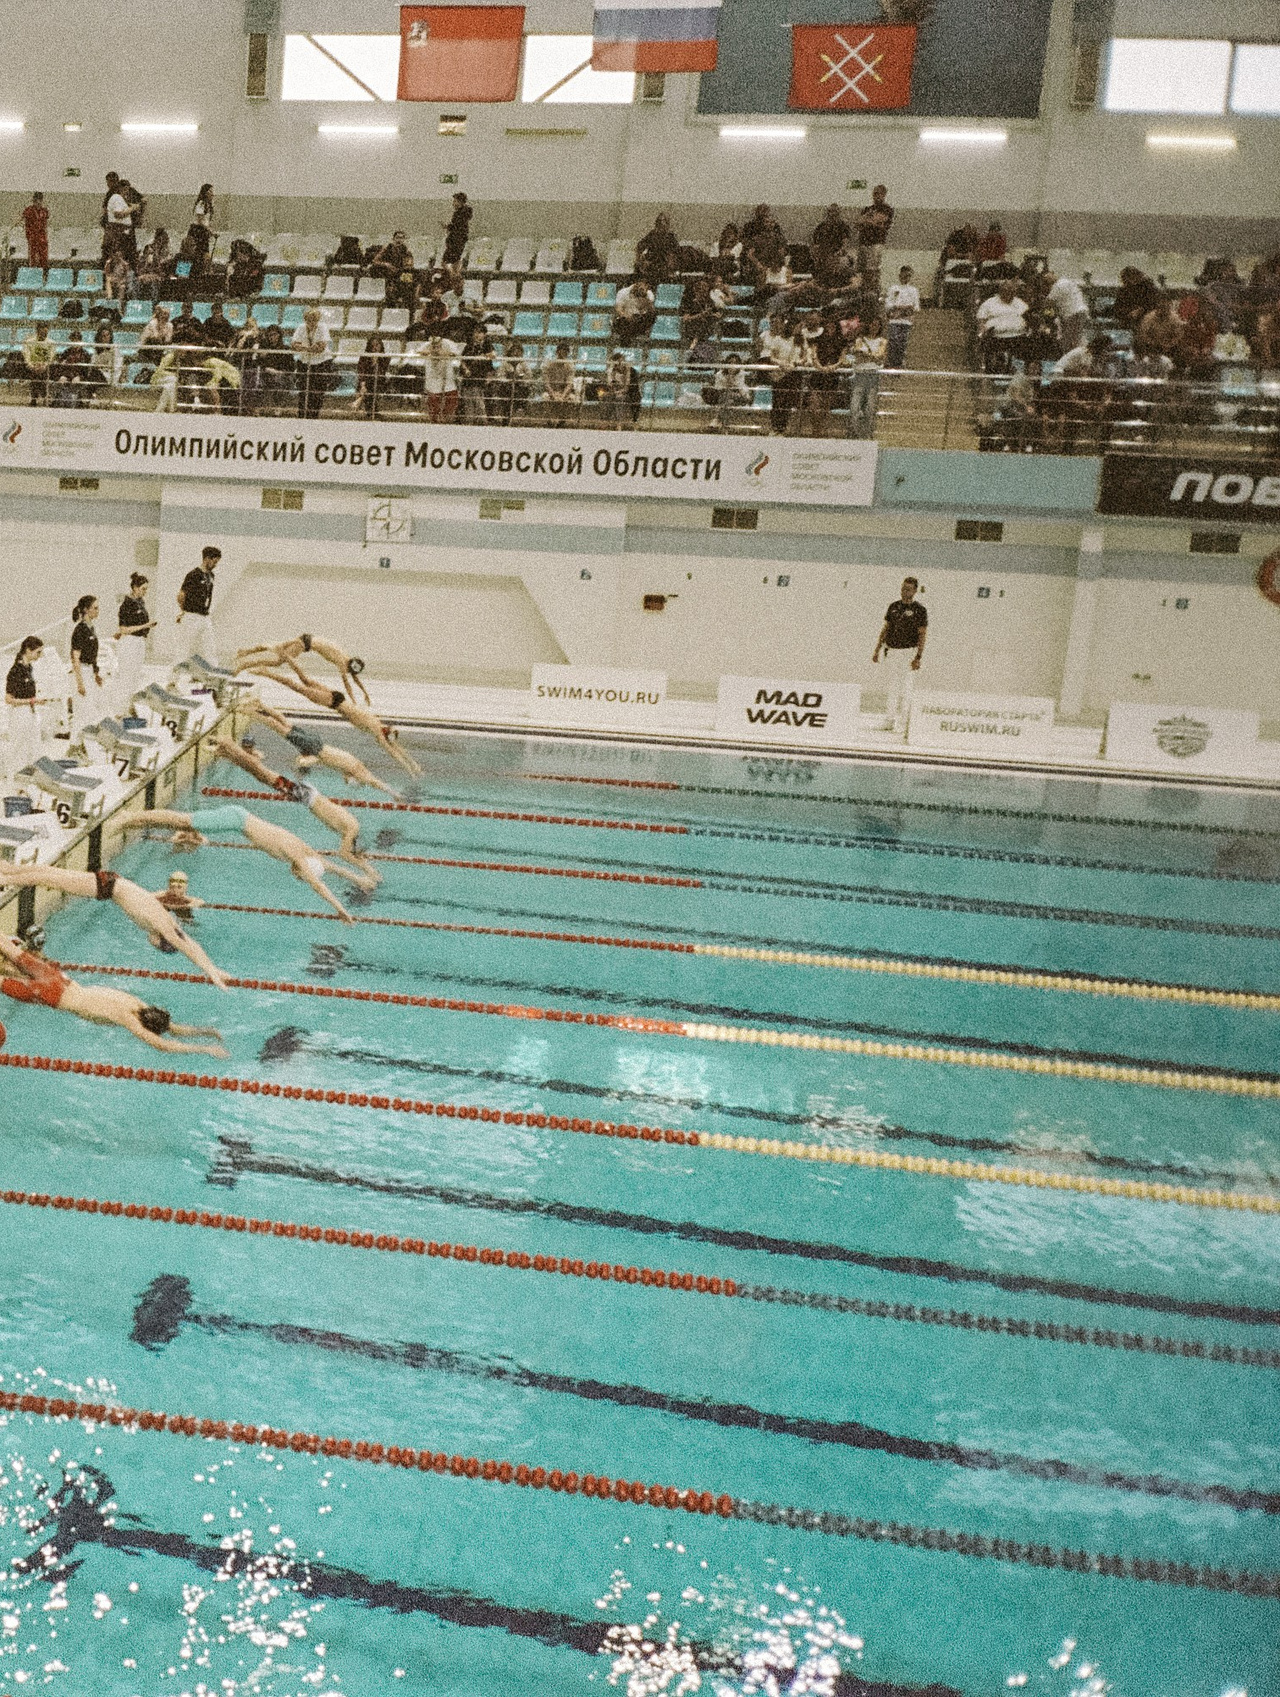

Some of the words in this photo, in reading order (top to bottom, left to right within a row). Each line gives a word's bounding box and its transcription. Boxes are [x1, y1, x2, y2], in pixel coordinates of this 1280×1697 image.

[114, 428, 306, 463] Олимпийский
[314, 441, 396, 467] совет
[404, 440, 583, 475] Московской
[592, 449, 722, 481] Области
[537, 685, 660, 705] SWIM4YOU.RU
[754, 689, 823, 708] MAD
[745, 707, 829, 728] WAVE
[939, 720, 1021, 737] RUSWIM.RU
[115, 758, 129, 778] 7
[56, 802, 71, 825] 6
